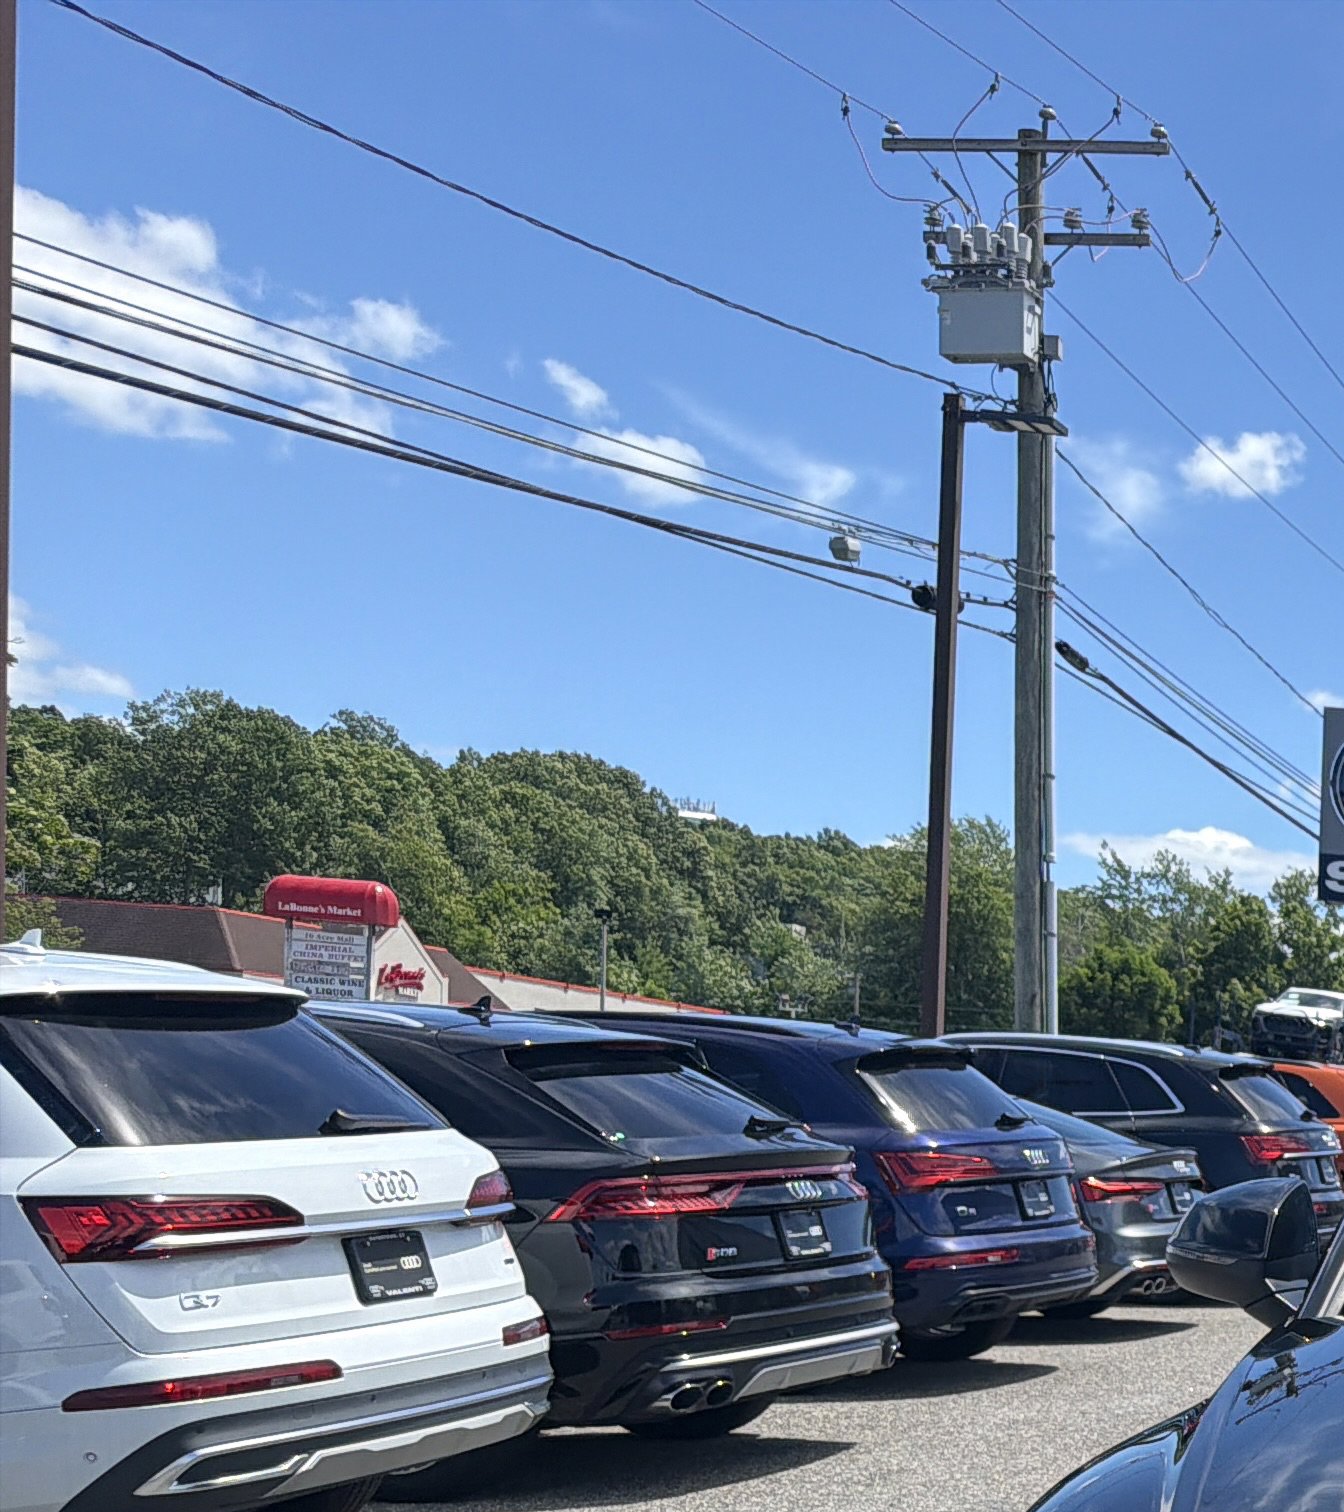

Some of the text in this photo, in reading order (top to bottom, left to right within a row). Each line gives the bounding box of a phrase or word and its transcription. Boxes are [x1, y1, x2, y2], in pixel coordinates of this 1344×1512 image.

[278, 901, 362, 917] LaBonne's Market
[305, 943, 355, 954] IMPERIAL
[292, 950, 366, 962] CHINA BUFFET
[294, 975, 365, 988] CLASSIC WINE
[315, 987, 354, 997] LIQUOR
[179, 1293, 221, 1311] Q7
